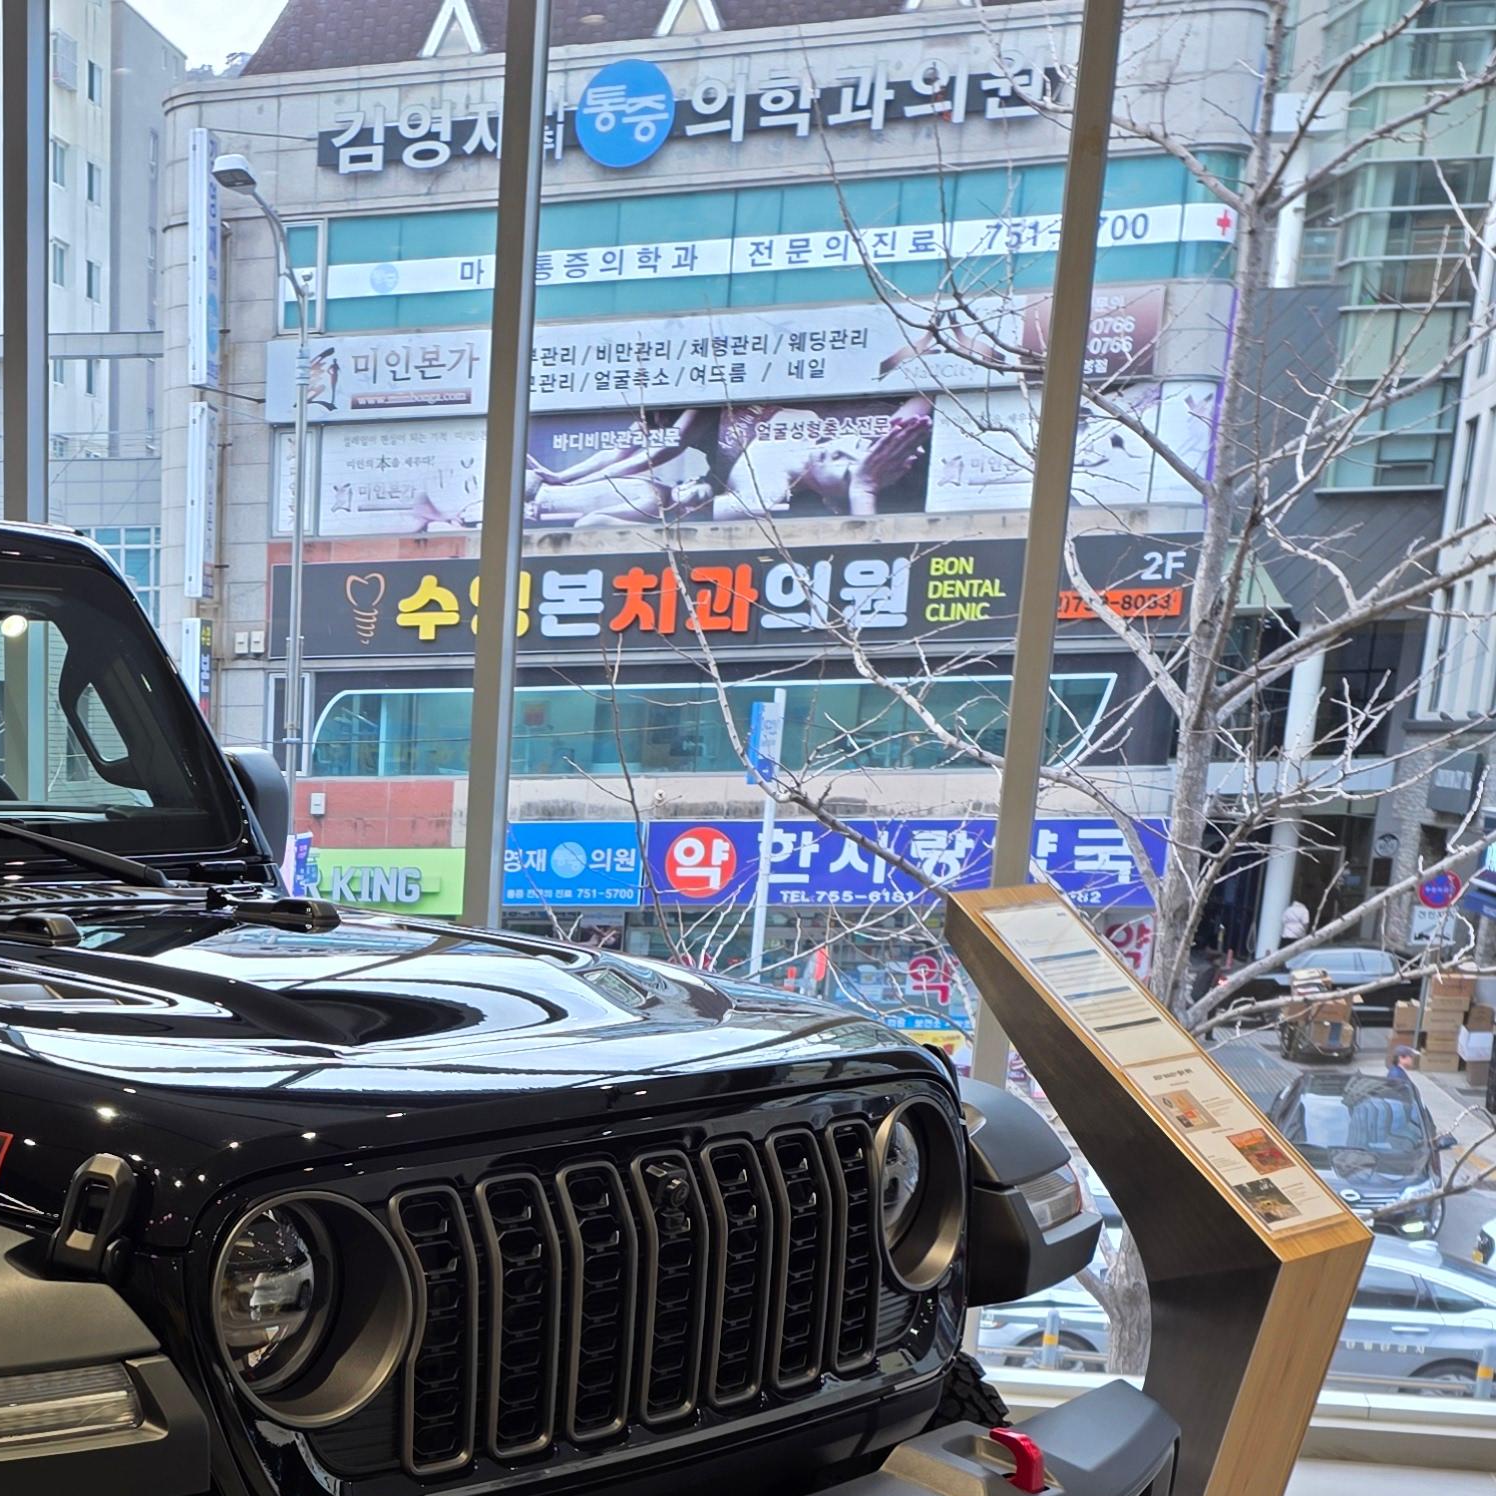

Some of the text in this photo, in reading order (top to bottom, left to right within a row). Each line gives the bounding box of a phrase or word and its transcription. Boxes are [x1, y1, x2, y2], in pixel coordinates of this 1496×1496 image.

[748, 235, 850, 267] 전문의
[352, 342, 480, 384] 미인본가
[787, 357, 826, 380] 네일
[929, 556, 974, 576] BON
[1141, 551, 1186, 581] 2F
[927, 579, 1006, 599] DENTAL
[925, 602, 992, 622] CLINIC
[589, 848, 636, 873] 의원
[673, 837, 731, 890] 약
[332, 866, 422, 903] KING
[576, 888, 634, 899] 751-5700
